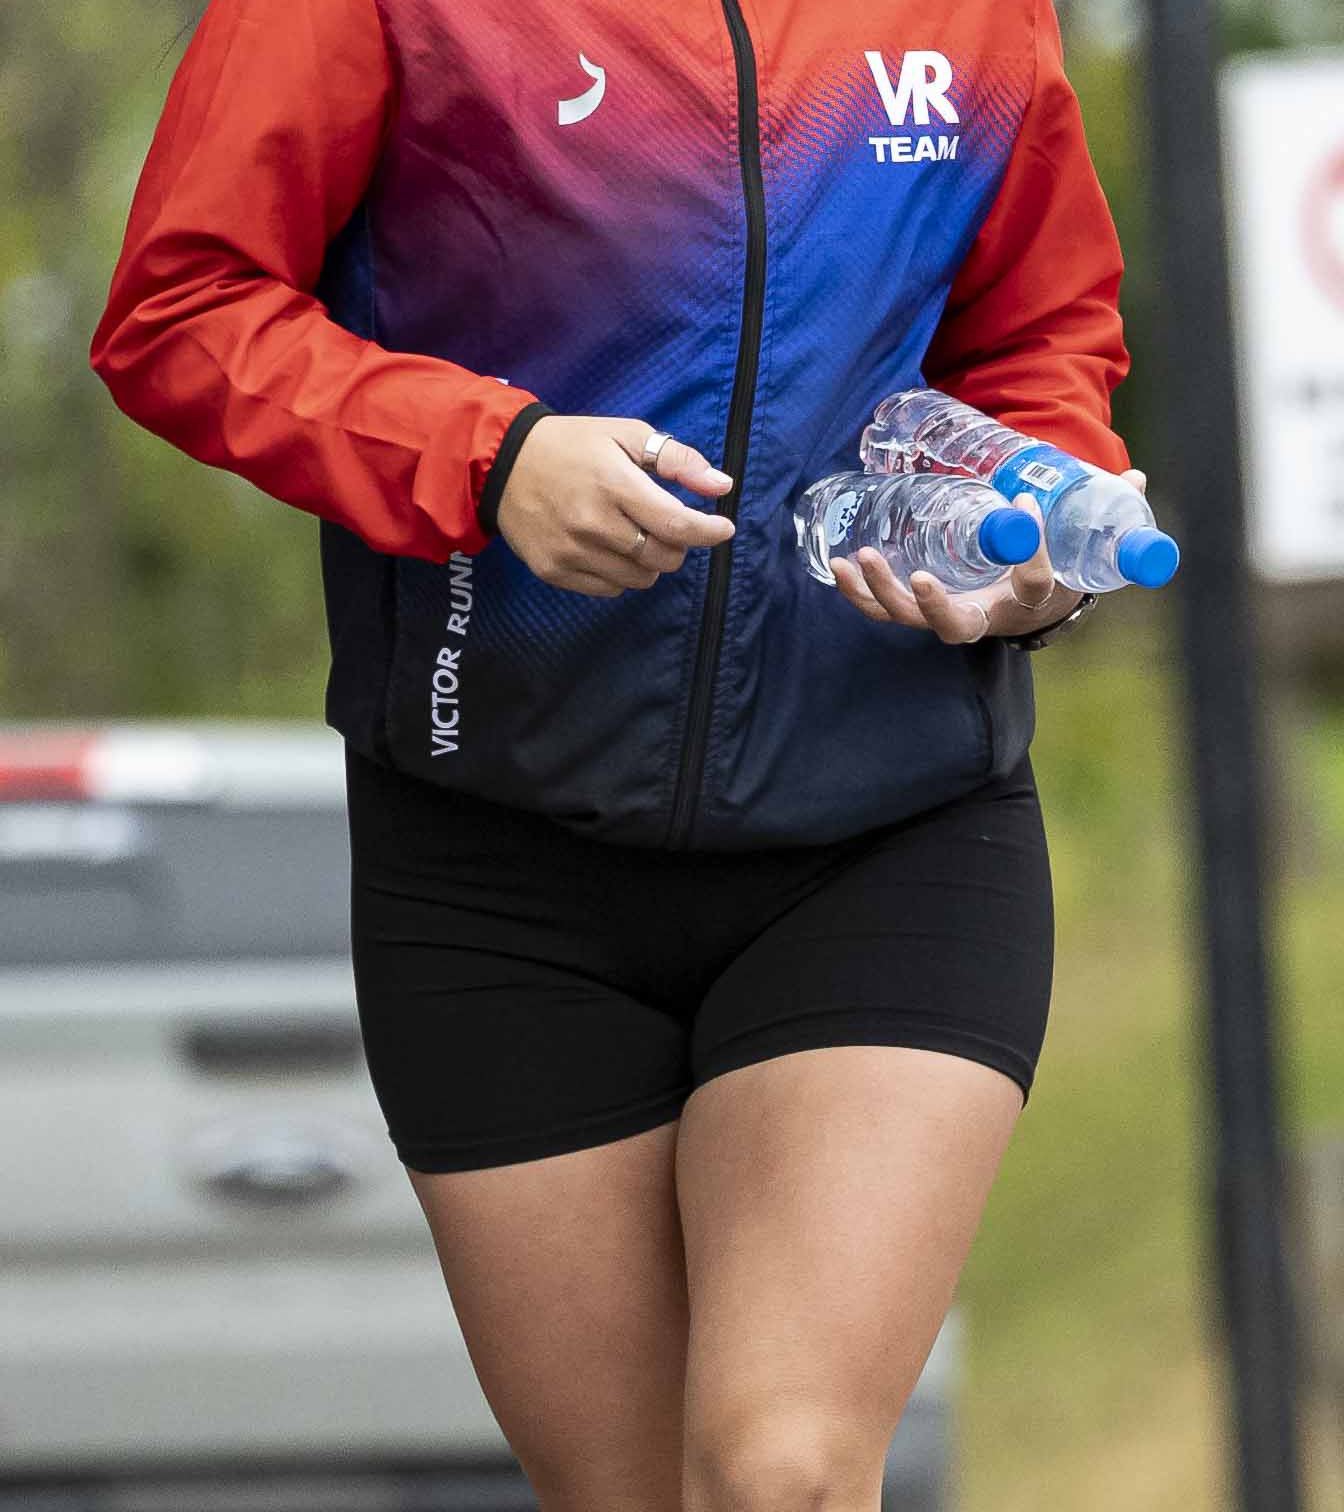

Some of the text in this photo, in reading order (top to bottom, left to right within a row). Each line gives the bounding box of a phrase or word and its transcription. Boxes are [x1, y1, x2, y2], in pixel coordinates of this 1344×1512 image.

[864, 50, 960, 126] VR
[869, 135, 960, 163] TEAM
[431, 647, 462, 756] VICTOR
